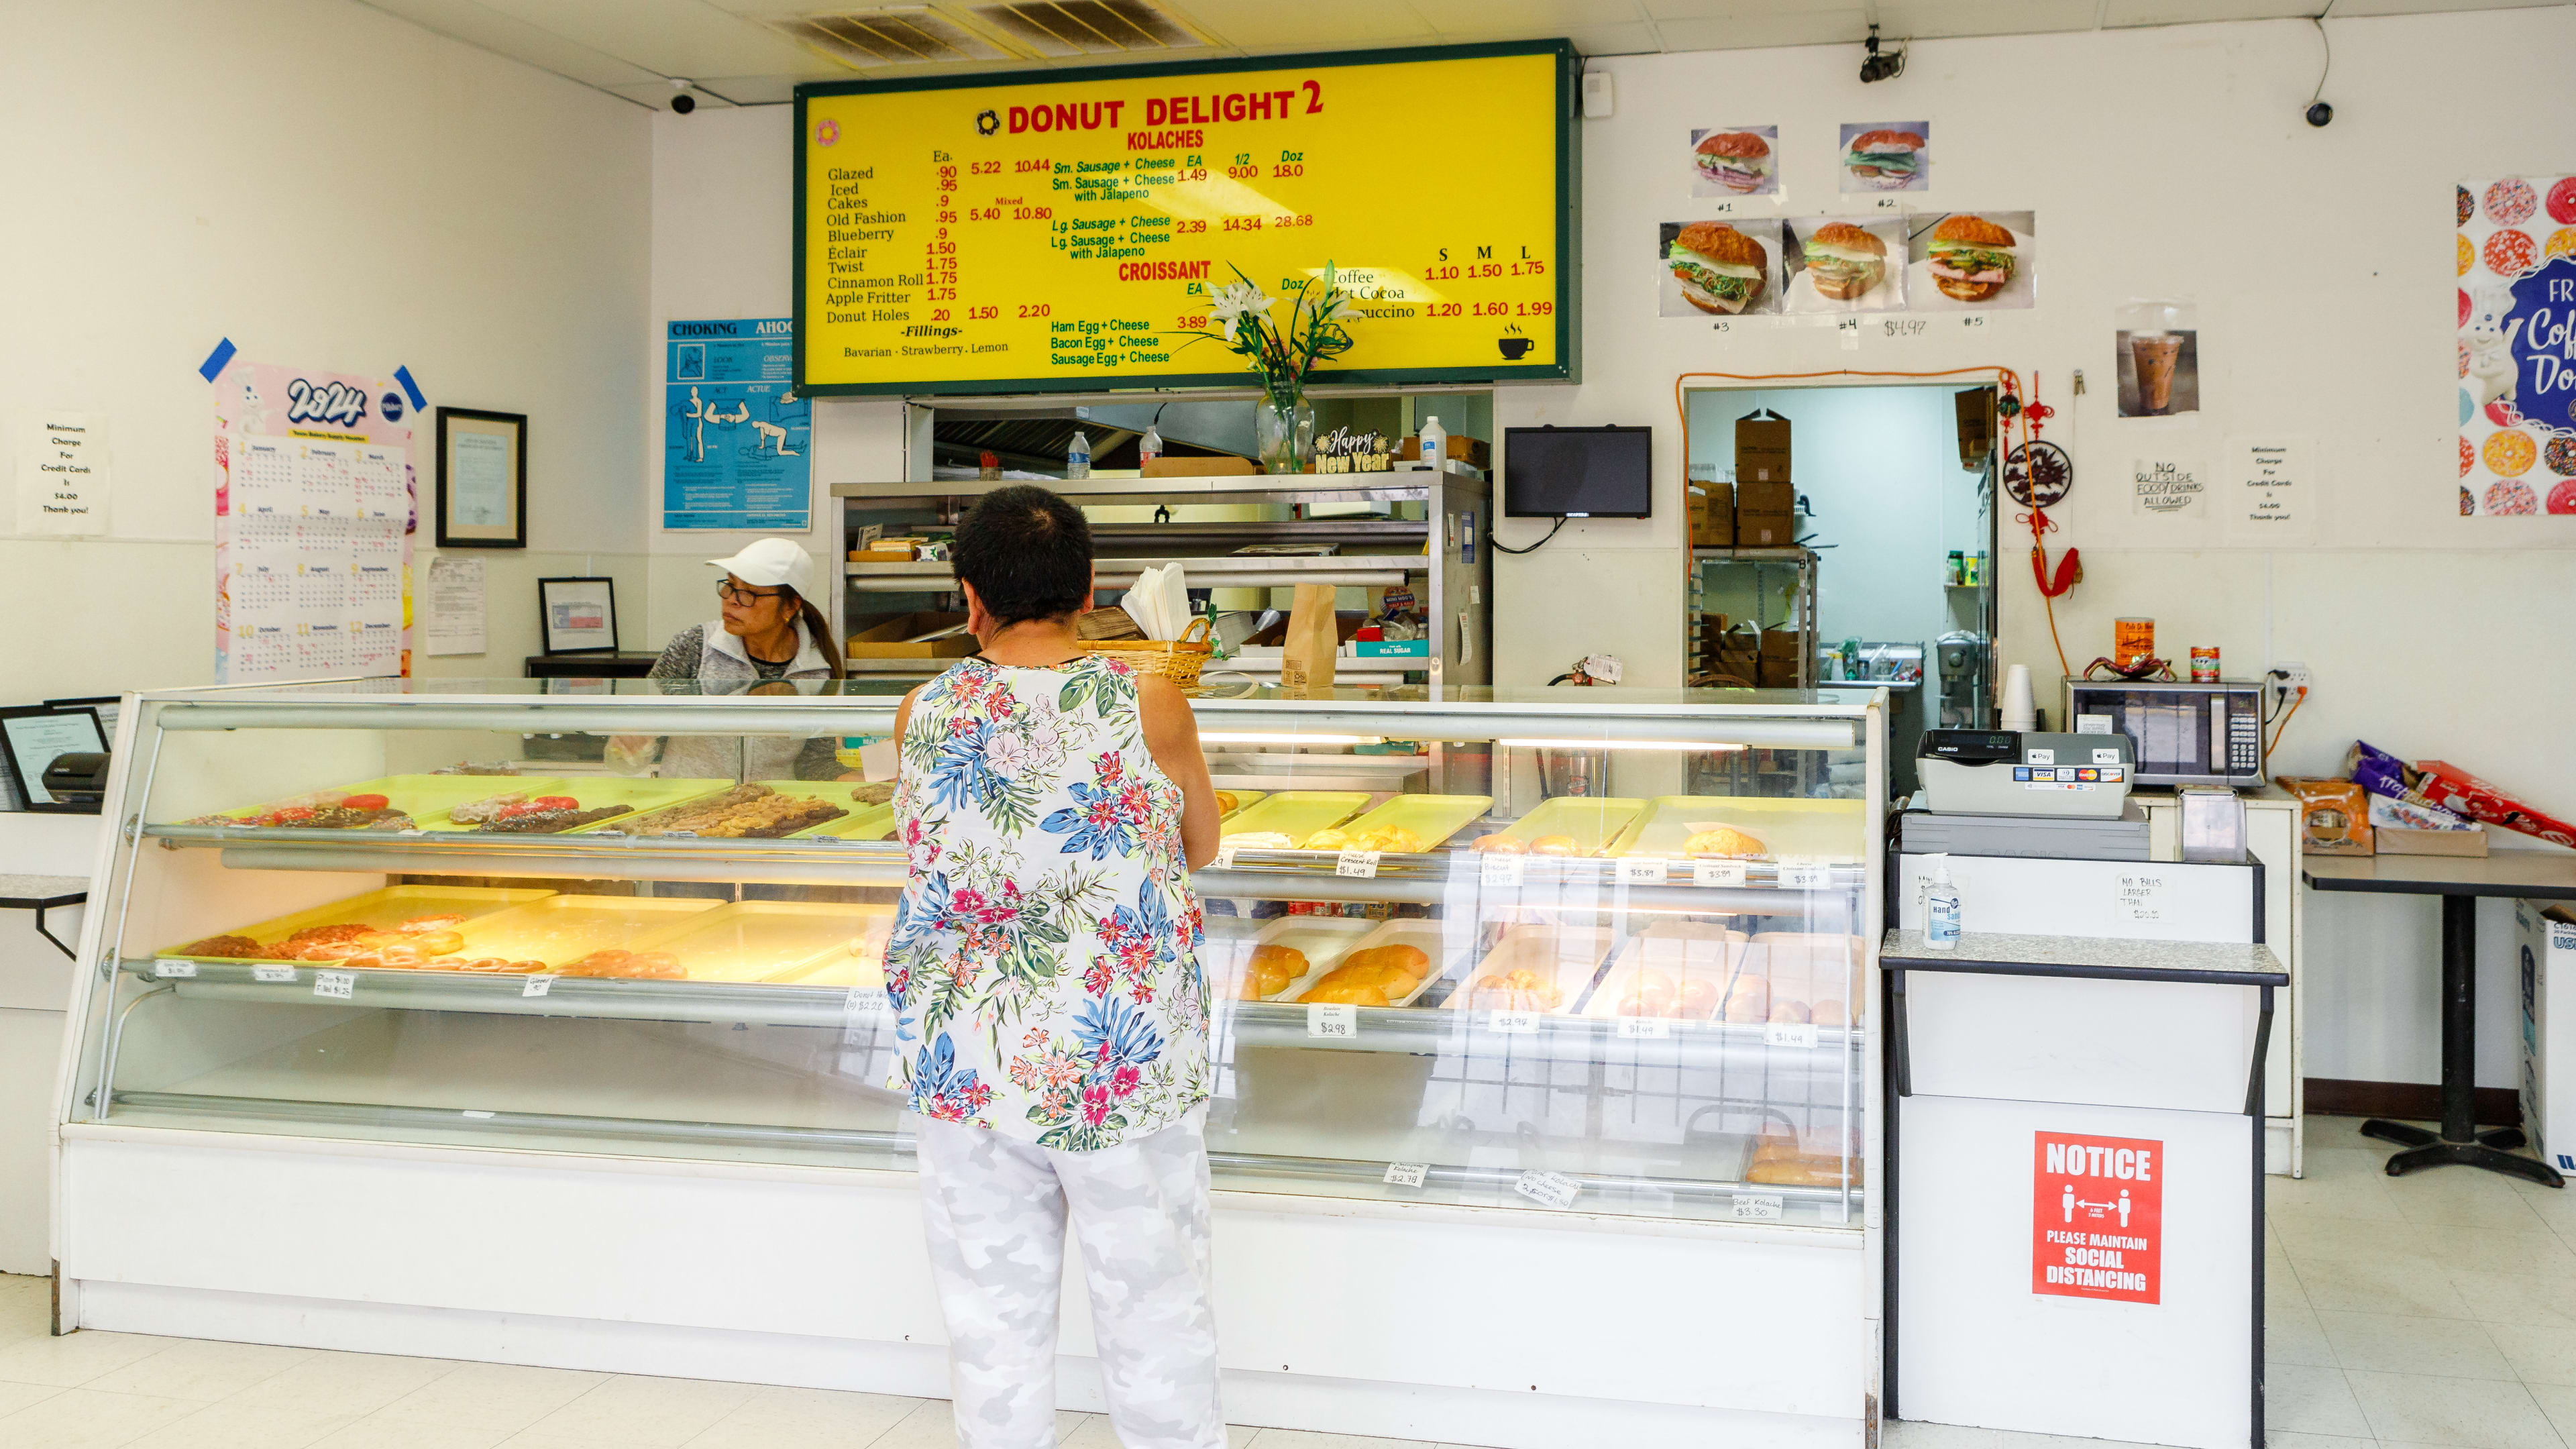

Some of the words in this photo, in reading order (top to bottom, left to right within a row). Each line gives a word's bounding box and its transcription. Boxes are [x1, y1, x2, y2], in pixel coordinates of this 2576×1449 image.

[1008, 100, 1125, 134] DONUT
[1146, 90, 1295, 127] DELIGHT
[1302, 79, 1324, 114] 2
[1127, 129, 1204, 151] KOLACHES
[934, 150, 953, 162] Ea.
[1187, 155, 1201, 166] EA
[1236, 154, 1250, 165] 1/2
[1281, 150, 1303, 162] Doz
[828, 166, 873, 180] Glazed
[936, 165, 958, 178] .90
[971, 161, 1001, 175] 5.22
[1015, 158, 1051, 173] 10.44
[1054, 162, 1073, 174] Sm.
[1077, 161, 1120, 174] Sausage
[1136, 158, 1175, 170] Cheese
[1179, 168, 1207, 181] 1.49
[1228, 165, 1258, 178] 9.00
[1273, 164, 1303, 177] 18.0
[831, 182, 859, 196] Iced
[936, 177, 957, 191] .95
[1053, 178, 1071, 190] Sm.
[1075, 177, 1118, 193] Sausage
[1135, 174, 1174, 185] Cheese
[828, 197, 867, 210] Cakes
[936, 195, 949, 207] .9
[996, 197, 1022, 205] Mixed
[1075, 190, 1096, 201] with
[1100, 188, 1149, 203] Jalapeno
[1717, 203, 1732, 212] #1
[1878, 199, 1896, 208] #2
[826, 213, 849, 226] Old
[855, 211, 906, 224] Fashion
[936, 211, 957, 223] .95
[970, 208, 1000, 221] 5.40
[1014, 207, 1052, 219] 10.80
[1072, 219, 1116, 231] Sausage
[1131, 216, 1170, 227] Cheese
[1177, 221, 1206, 233] 2.39
[1224, 218, 1261, 231] 14.34
[1275, 215, 1313, 227] 28.68
[828, 229, 894, 242] Blueberry
[936, 227, 947, 239] .9
[1071, 235, 1114, 250] Sausage
[1130, 232, 1170, 244] Cheese
[828, 246, 867, 260] Éclair
[926, 241, 955, 254] 1.50
[1070, 247, 1092, 259] with
[1096, 246, 1144, 260] Jalapeno
[1440, 248, 1447, 261] S
[1478, 246, 1491, 259] M
[1521, 246, 1530, 259] L
[828, 261, 863, 274] Twist
[926, 257, 957, 270] 1.75
[1119, 261, 1211, 281] CROISSANT
[1426, 266, 1459, 280] 1.10
[1468, 264, 1502, 278] 1.50
[1511, 261, 1544, 276] 1.75
[828, 278, 894, 288] Cinnamon
[898, 274, 923, 286] Roll
[926, 272, 957, 284] 1.75
[1187, 283, 1202, 294] EA
[1281, 278, 1303, 290] Doz
[826, 291, 863, 307] Apple
[867, 292, 910, 303] Fritter
[928, 288, 956, 301] 1.75
[1360, 286, 1404, 299] Cocoa
[827, 311, 866, 323] Donut
[873, 309, 909, 321] Holes
[931, 309, 950, 321] .20
[969, 306, 998, 319] 1.50
[1019, 304, 1050, 318] 2.20
[1427, 303, 1462, 317] 1.20
[1473, 303, 1508, 315] 1.60
[1517, 302, 1552, 316] 1.99
[672, 323, 737, 335] CHOKING
[1052, 321, 1074, 332] Ham
[1079, 321, 1099, 335] Egg
[1110, 319, 1149, 331] Cheese
[1177, 316, 1207, 329] 3.89
[1713, 322, 1729, 331] #3
[1839, 319, 1857, 330] #4
[1964, 317, 1983, 326] #5
[901, 325, 962, 339] -Fillings-
[845, 347, 891, 357] Bavarian
[972, 344, 1008, 353] Lemon
[1051, 337, 1082, 349] Bacon
[1085, 337, 1106, 351] Egg
[1119, 335, 1159, 347] Cheese
[1052, 354, 1095, 367] Sausage
[1097, 352, 1117, 366] Egg
[1128, 350, 1169, 363] Cheese
[2526, 354, 2576, 394] Do
[288, 378, 367, 427] 2024
[46, 423, 86, 433] Minimum
[52, 437, 81, 447] Charge
[1330, 426, 1373, 455] Happy
[60, 451, 73, 460] For
[1316, 453, 1350, 474] New
[1352, 451, 1389, 472] Year
[41, 464, 66, 473] Credit
[69, 466, 91, 474] Cards
[2155, 462, 2176, 472] NO
[2136, 472, 2193, 482] OUTSIDE
[2144, 495, 2192, 505] ALLOWED
[43, 505, 68, 514] Thank
[71, 507, 89, 515] you!
[1339, 865, 1365, 876] $1.49
[2123, 877, 2133, 887] NO
[2124, 888, 2152, 896] LARGER
[1322, 1022, 1346, 1034] $2.98
[1499, 1018, 1528, 1026] $2.97
[1776, 1032, 1803, 1044] $1.49
[2046, 1142, 2151, 1181] NOTICE
[1390, 1175, 1417, 1183] $2.78
[1755, 1199, 1781, 1208] Kolache
[1736, 1208, 1768, 1216] $3.30
[2047, 1230, 2086, 1246] PLEASE
[2089, 1234, 2147, 1250] MAINTAIN
[2065, 1247, 2124, 1269] SOCIAL
[2047, 1265, 2146, 1291] DISTANCING
